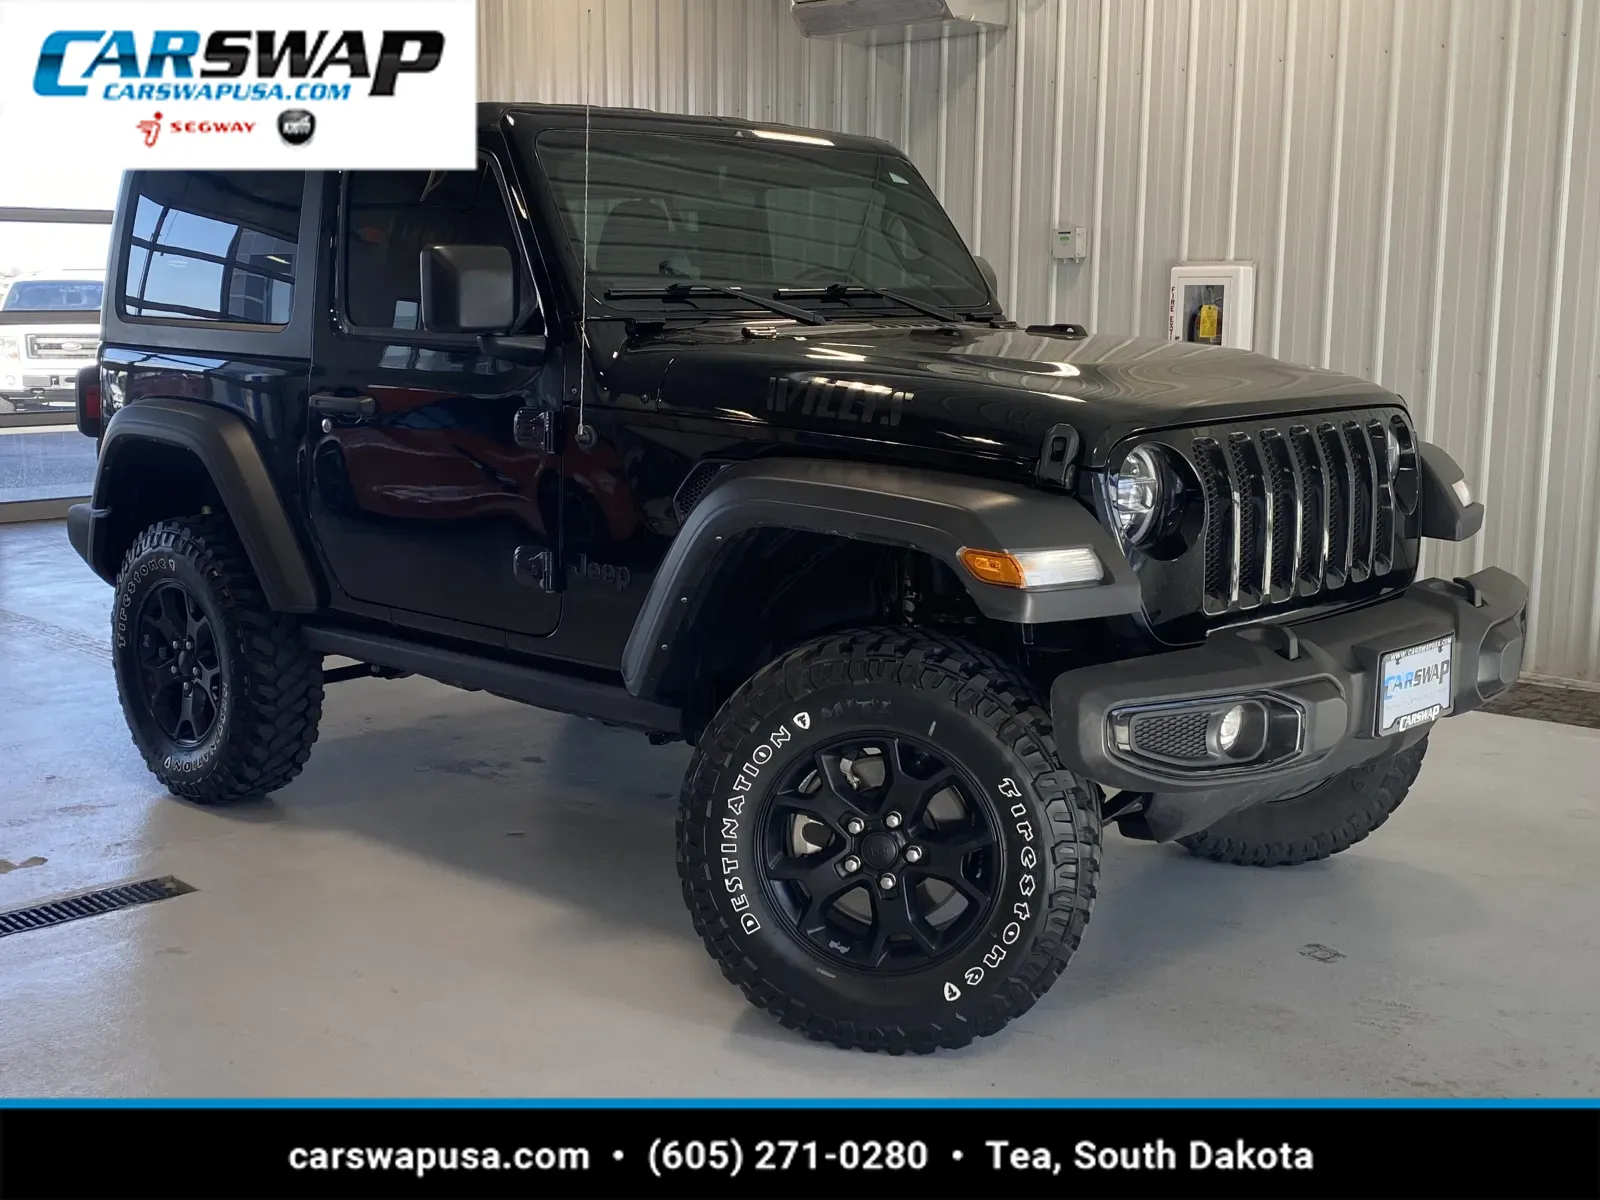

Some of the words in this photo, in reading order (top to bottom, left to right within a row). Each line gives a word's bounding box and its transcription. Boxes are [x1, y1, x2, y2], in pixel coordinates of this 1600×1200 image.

[568, 552, 631, 592] Jeep
[1384, 659, 1450, 701] CARSWAP
[1398, 704, 1441, 732] CARSWAP
[720, 724, 797, 935] DESTINATION
[964, 776, 1038, 987] Firestone
